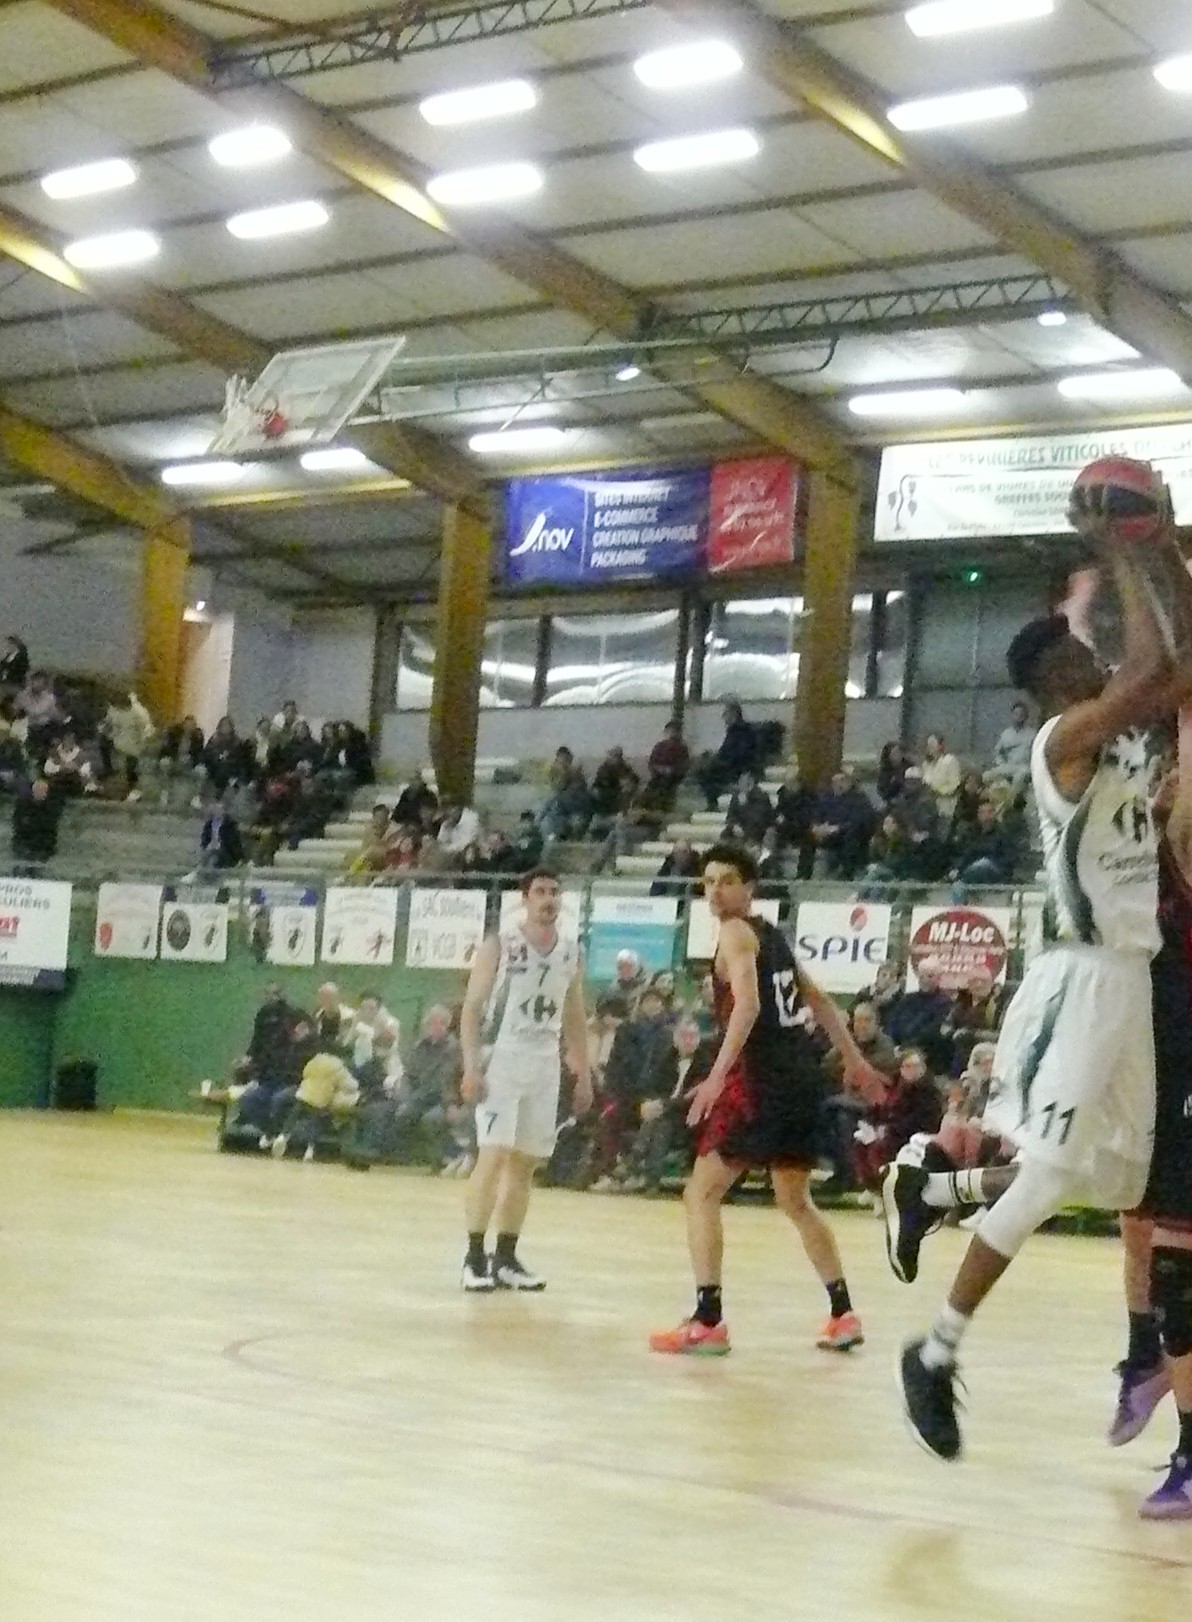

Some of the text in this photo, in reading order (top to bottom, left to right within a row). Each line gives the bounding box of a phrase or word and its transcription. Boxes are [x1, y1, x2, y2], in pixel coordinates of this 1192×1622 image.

[798, 933, 886, 964] SPIE
[484, 1111, 498, 1135] 7
[1041, 1101, 1077, 1146] 11
